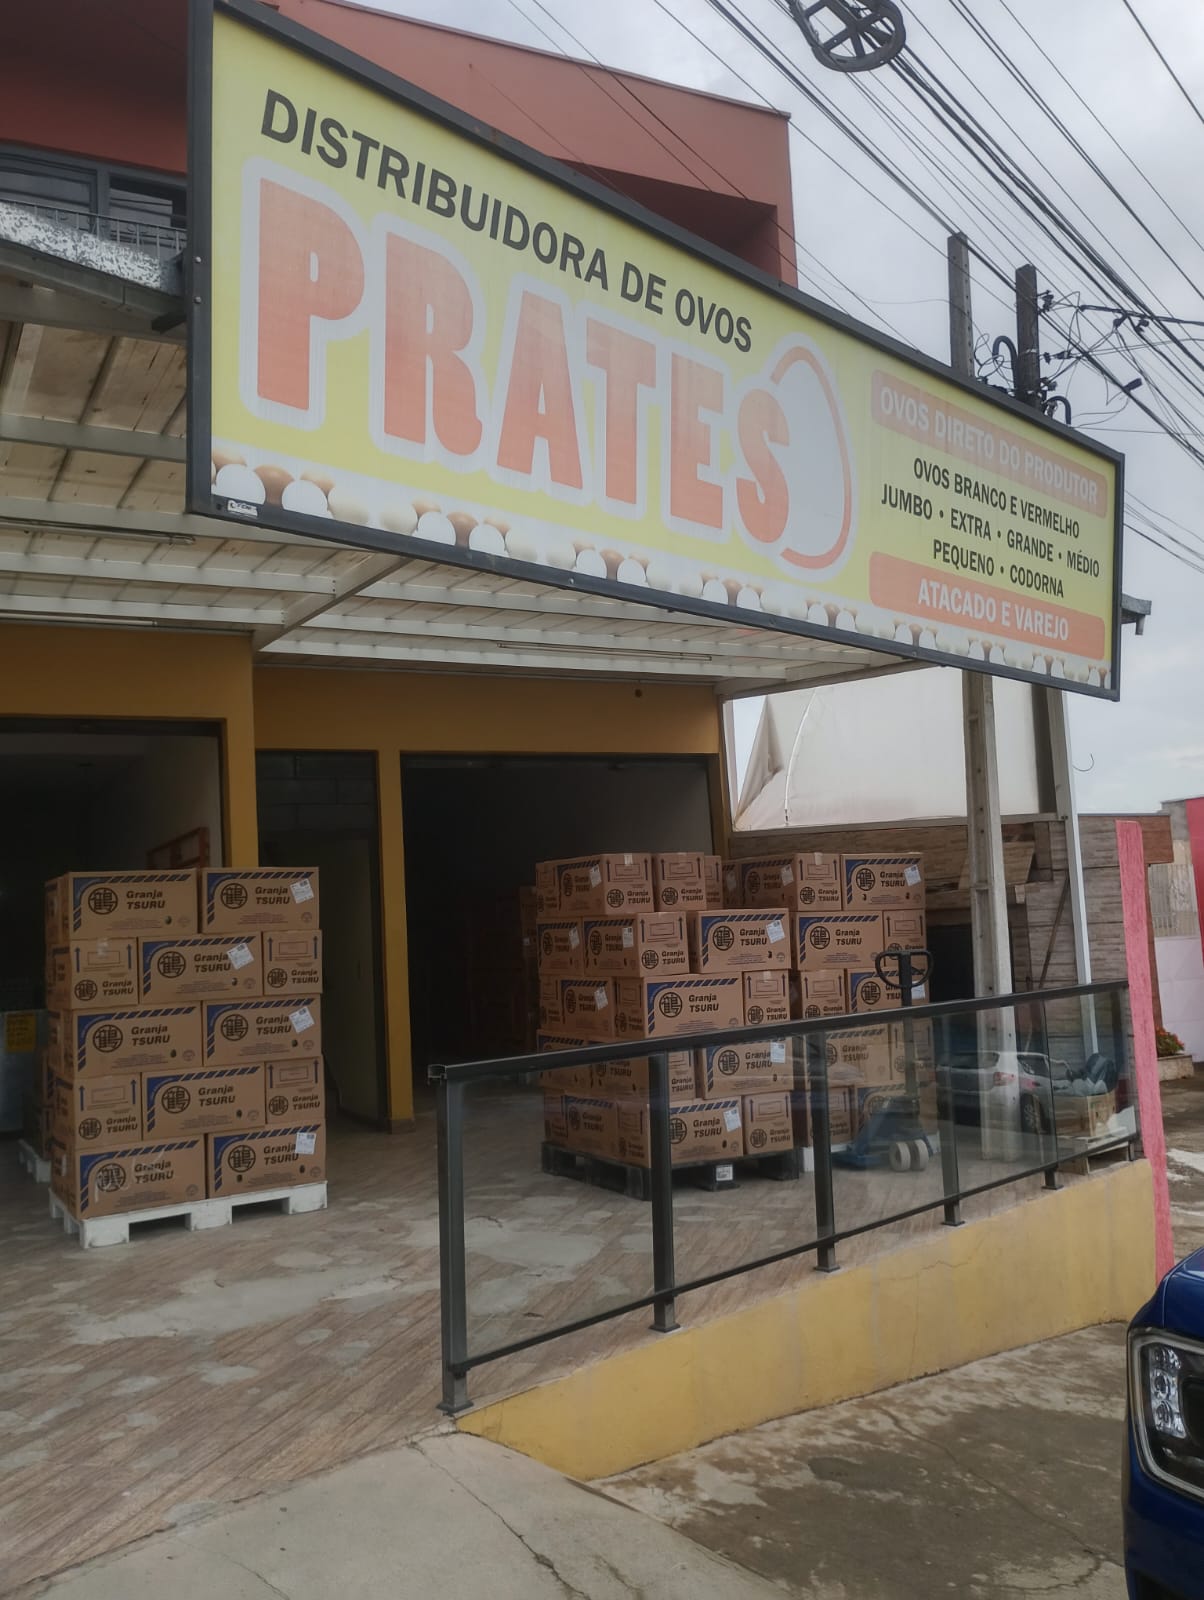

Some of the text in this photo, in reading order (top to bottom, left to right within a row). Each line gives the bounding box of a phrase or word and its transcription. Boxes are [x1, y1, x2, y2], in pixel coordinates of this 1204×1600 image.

[260, 89, 752, 353] DISTRIBUIDORA DE OVOS
[257, 177, 790, 544] PRATES
[880, 385, 1097, 505] OVOS DIRETO DO PRODUTOR
[914, 457, 1080, 539] OVOS BRANCO E VERMELHO
[881, 484, 1100, 578] JUMBO EXTRA GRANDE MÉDIO
[933, 539, 1064, 598] PEQUENO CODORNA
[917, 577, 1069, 641] ATACADO E VAREJO
[126, 889, 163, 899] Granja
[255, 886, 288, 896] Granja
[126, 900, 165, 910] TSURU
[256, 896, 290, 905] TSURU
[739, 928, 765, 937] Granja
[835, 929, 860, 937] Granja
[740, 938, 767, 946] TSURU
[836, 937, 862, 946] TSURU
[662, 957, 686, 965] TSURU
[195, 963, 231, 973] TSURU
[291, 969, 318, 977] Granja
[102, 979, 132, 988] Granja
[103, 987, 134, 996] TSURU
[688, 994, 717, 1003] Granja
[689, 1003, 719, 1013] TSURU
[256, 1015, 289, 1025] Granja
[767, 1013, 788, 1021] TSURU
[131, 1024, 168, 1035] Granja
[256, 1025, 292, 1036] TSURU
[132, 1035, 170, 1046] TSURU
[746, 1061, 772, 1070] TSURU
[198, 1085, 234, 1096] Granja
[199, 1096, 235, 1107] TSURU
[292, 1094, 318, 1103] Granja
[293, 1102, 320, 1111] TSURU
[106, 1115, 136, 1125] Granja
[693, 1117, 720, 1128] Granja
[106, 1124, 138, 1133] TSURU
[694, 1127, 722, 1138] TSURU
[264, 1153, 299, 1165] TSURU
[135, 1160, 171, 1172] Granja
[135, 1171, 174, 1184] TSURU
